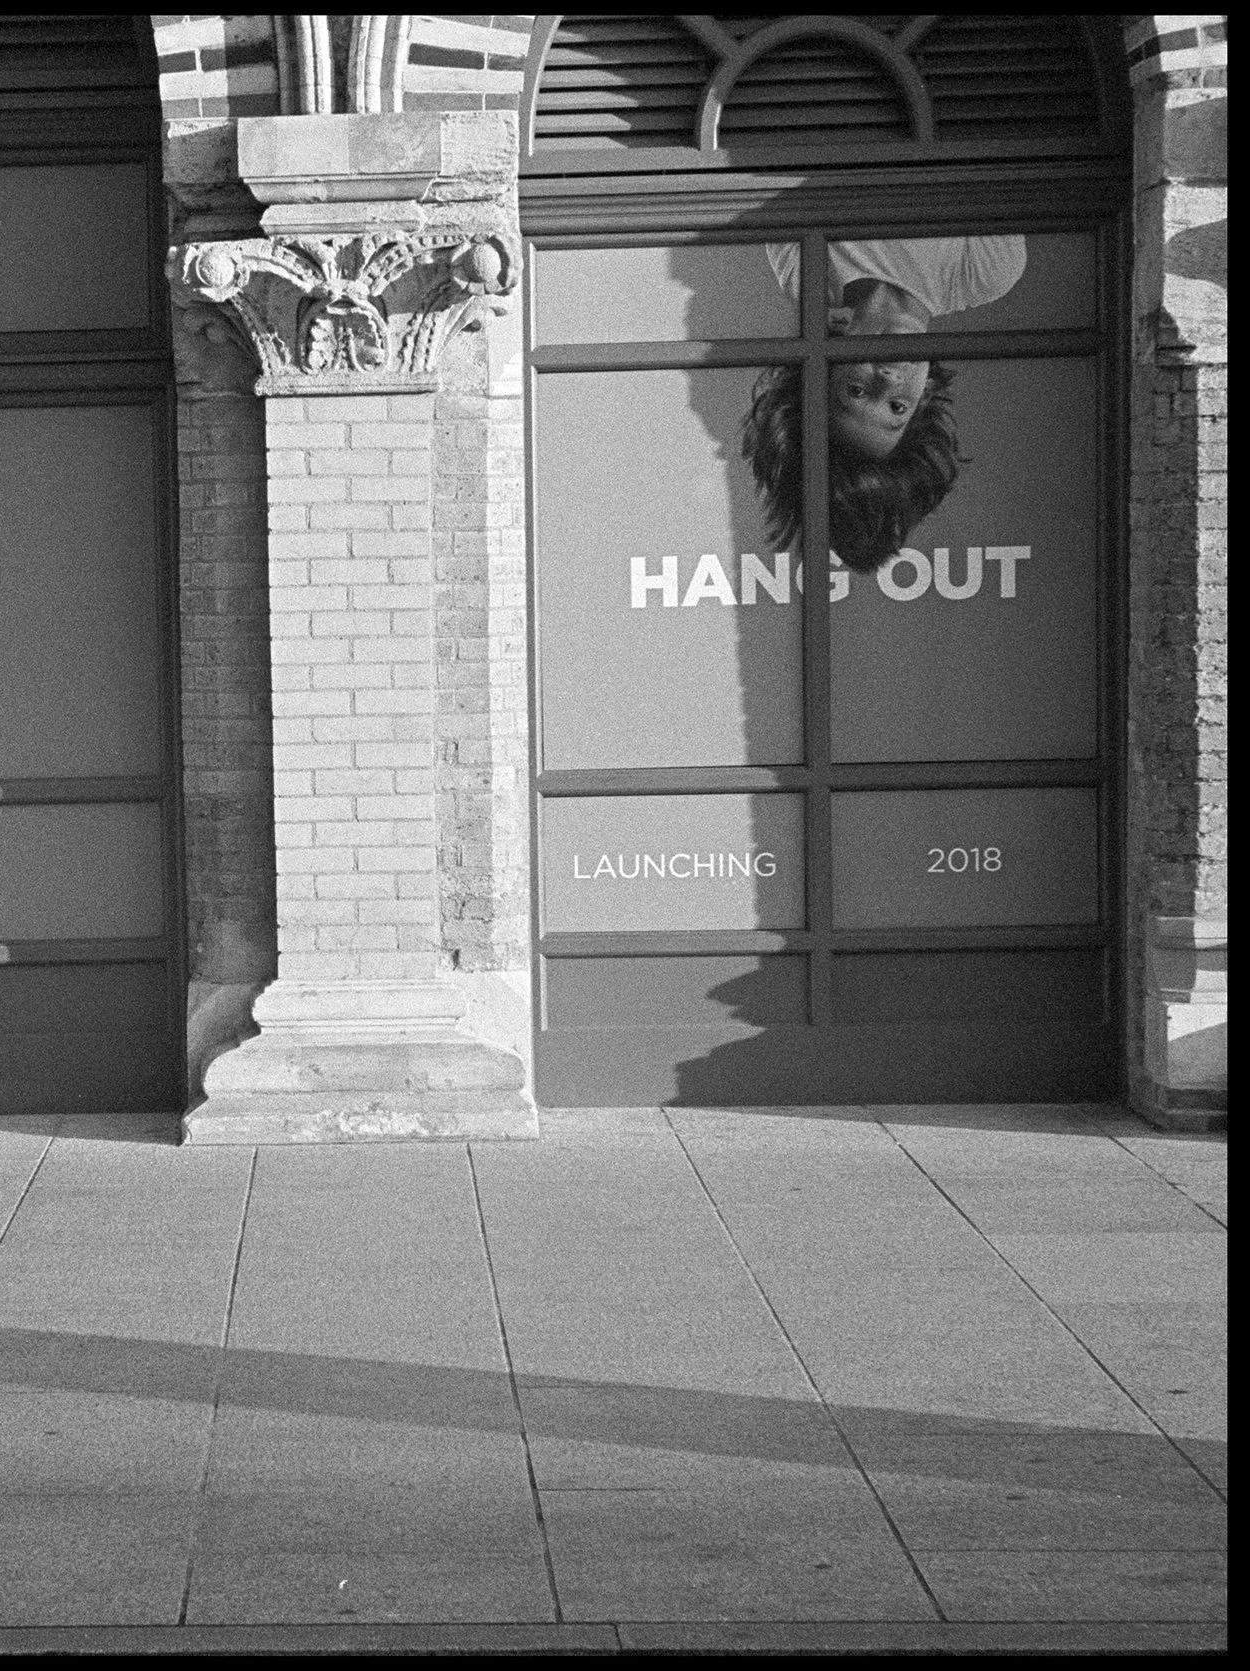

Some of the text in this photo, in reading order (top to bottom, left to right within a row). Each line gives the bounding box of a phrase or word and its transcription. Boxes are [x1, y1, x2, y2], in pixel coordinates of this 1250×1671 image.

[876, 546, 1032, 601] OUT
[574, 847, 1002, 879] LAUNCHING 2018
